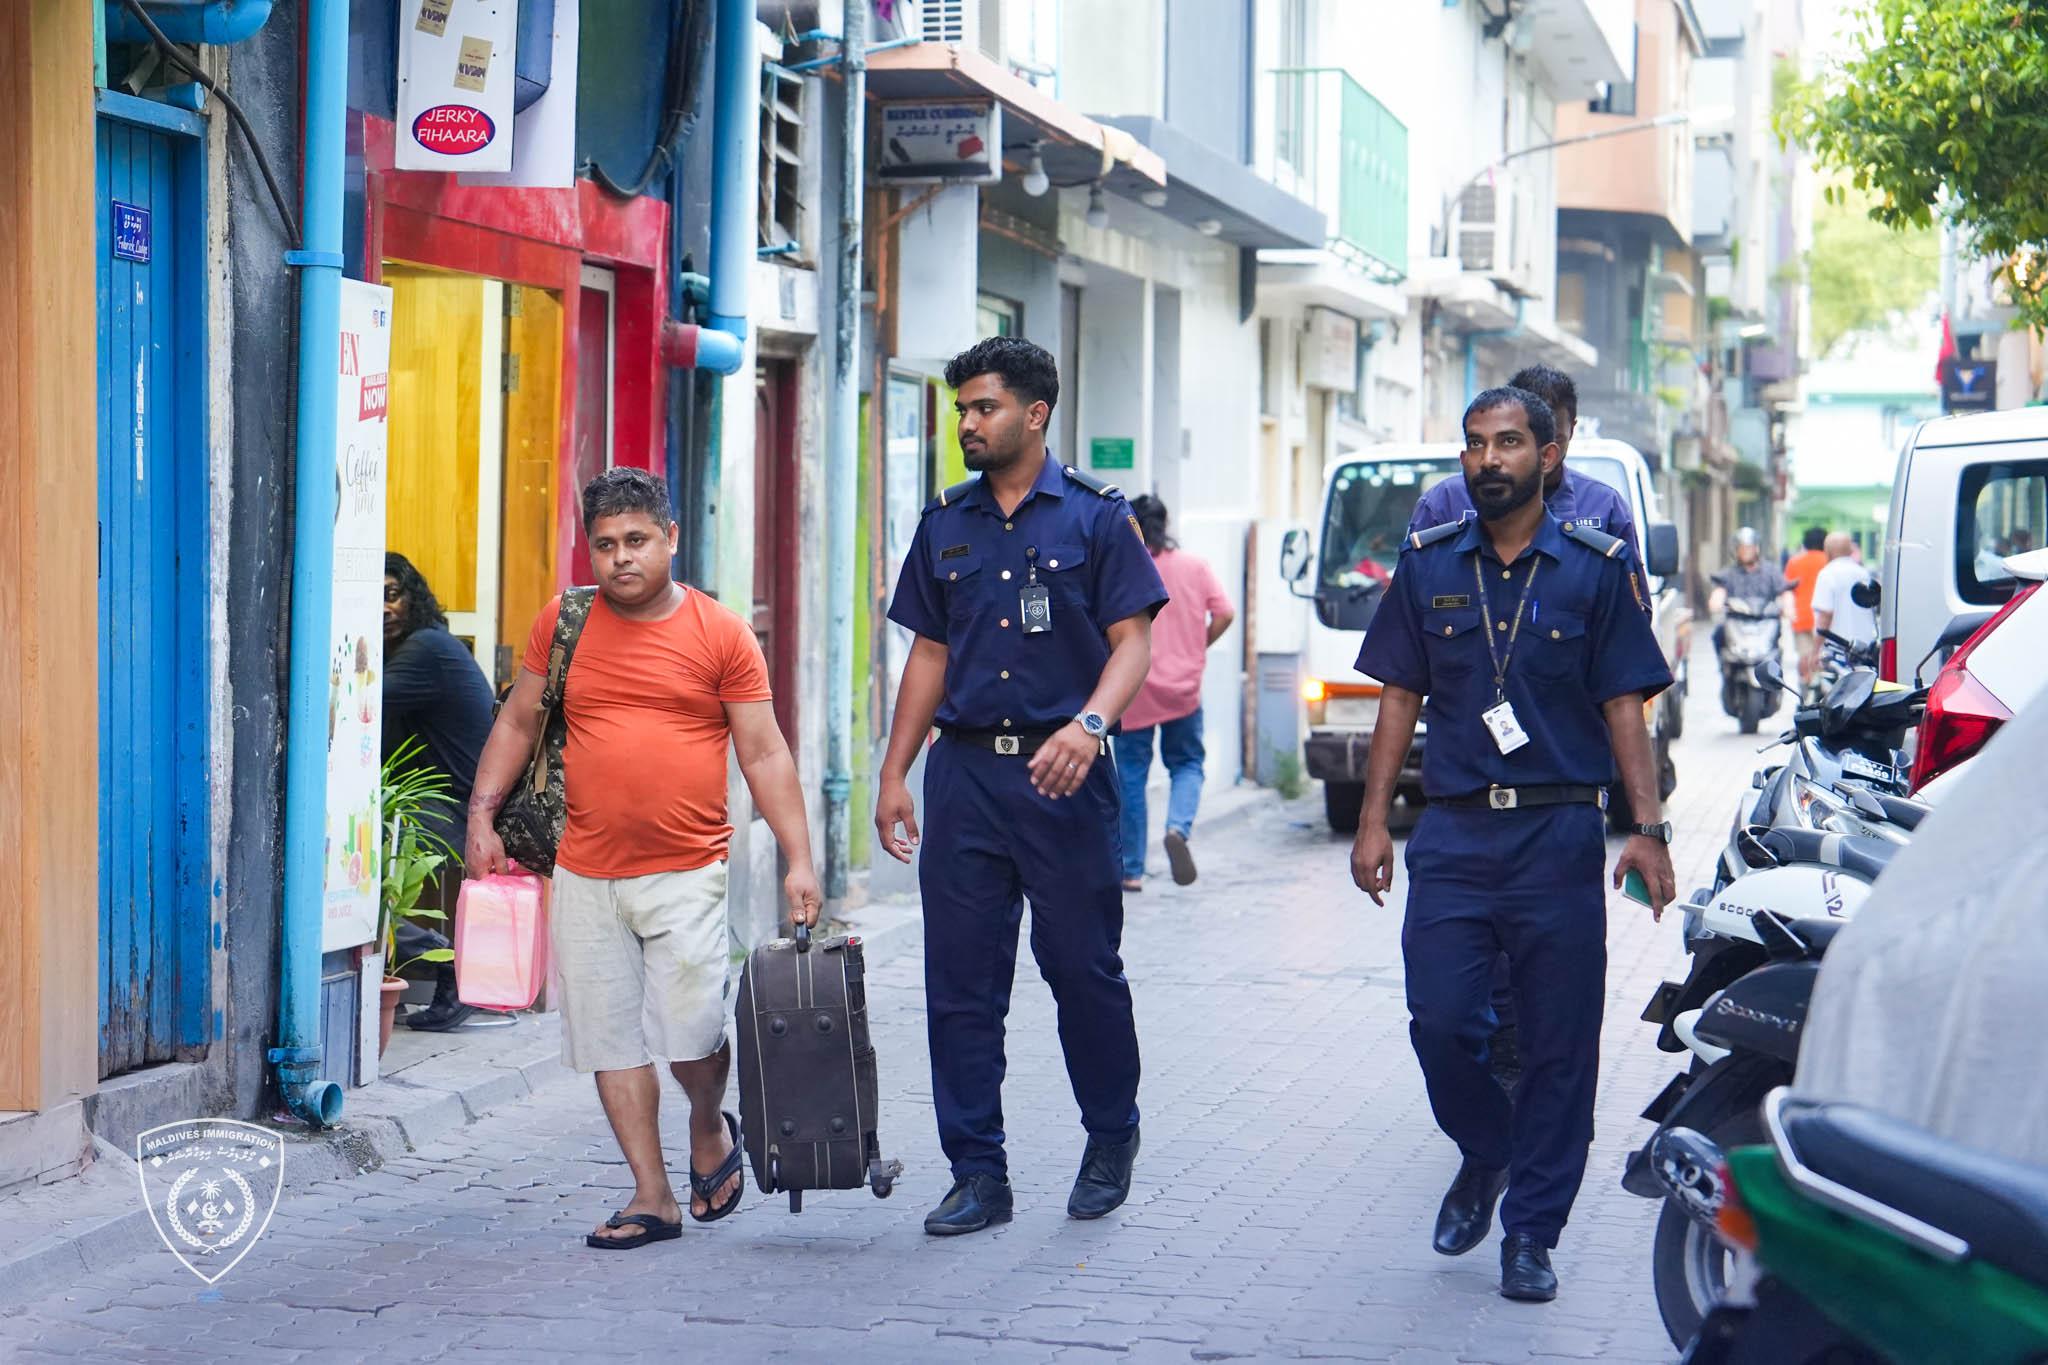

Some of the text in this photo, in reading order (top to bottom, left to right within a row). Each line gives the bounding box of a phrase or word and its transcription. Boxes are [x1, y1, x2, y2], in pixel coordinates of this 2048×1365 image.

[426, 109, 479, 124] JERKY
[417, 128, 489, 144] FIHAARA
[363, 386, 386, 411] NOW
[346, 444, 379, 492] Coffee
